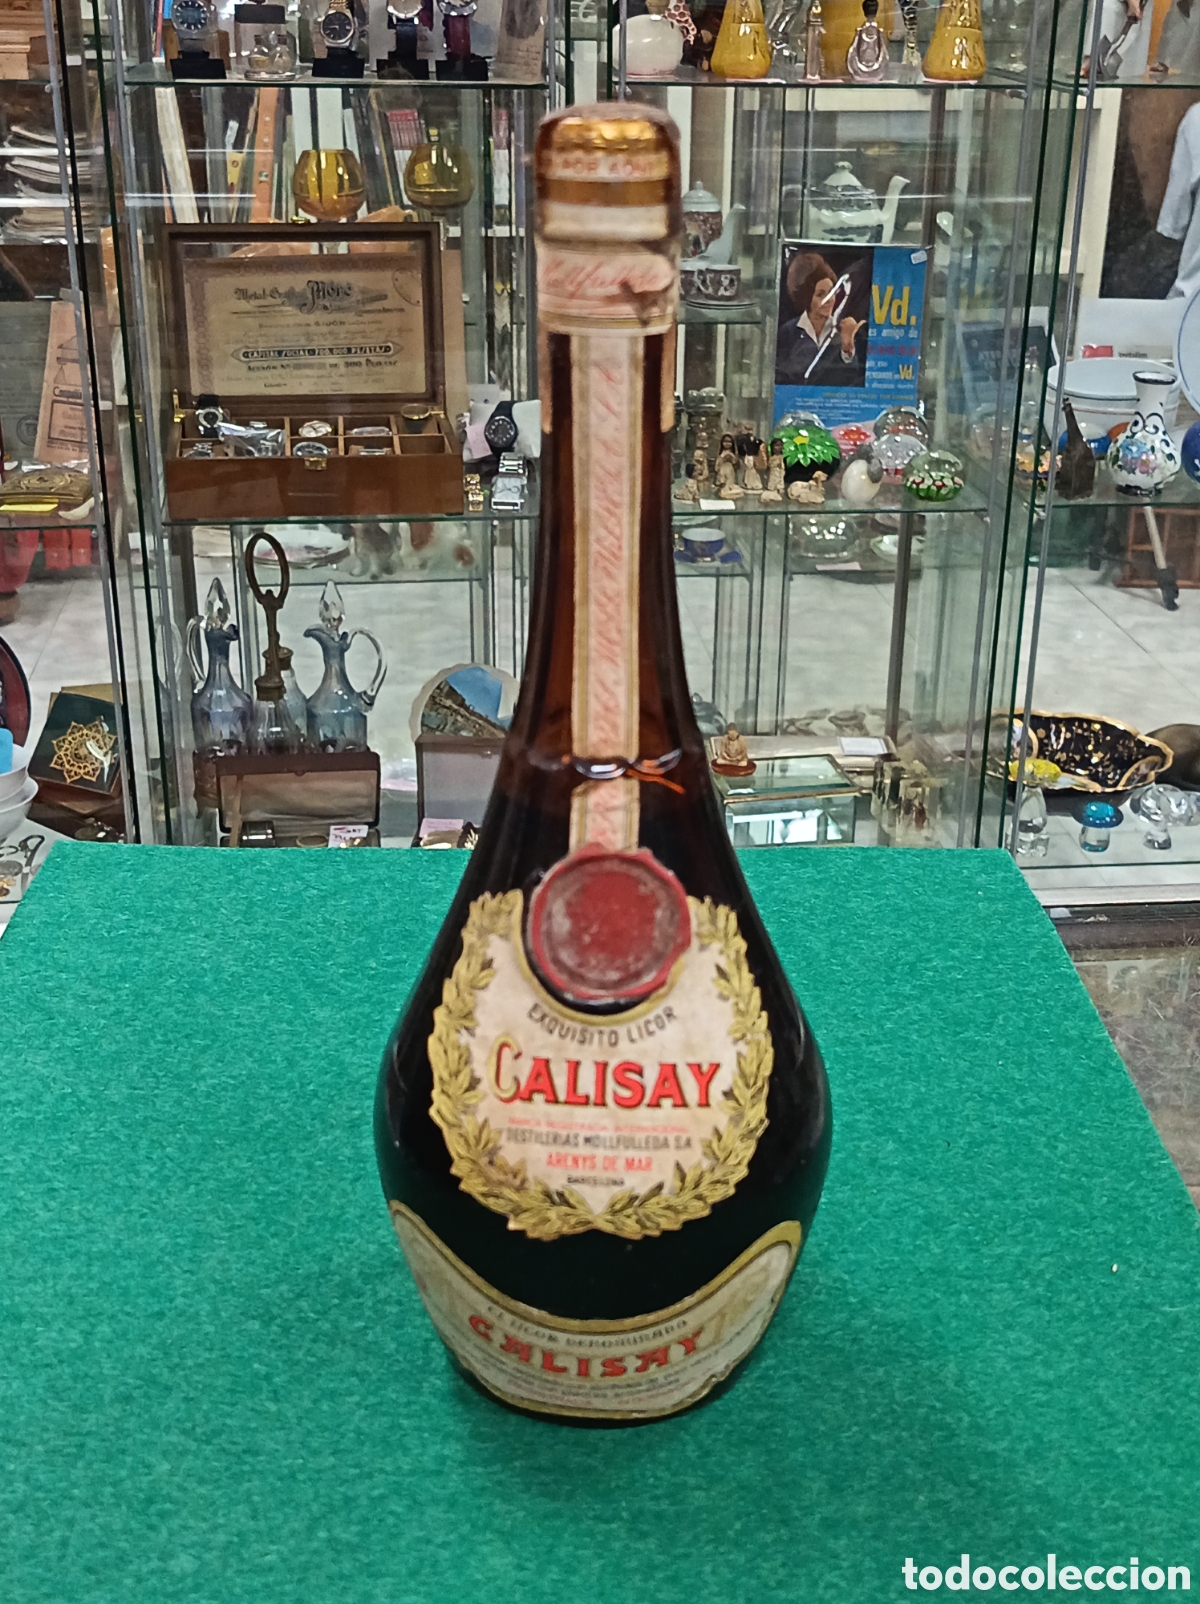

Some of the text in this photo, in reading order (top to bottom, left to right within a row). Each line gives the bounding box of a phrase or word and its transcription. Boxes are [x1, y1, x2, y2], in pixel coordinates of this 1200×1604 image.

[872, 284, 917, 326] Vd.
[899, 364, 915, 380] Vd.
[527, 1003, 679, 1047] EXQUISITO LICOR
[488, 1033, 720, 1109] CALISAY
[546, 1151, 653, 1173] ARENYS DE MAR
[567, 1174, 625, 1187] BARCELONA
[469, 1314, 703, 1378] CALISAY
